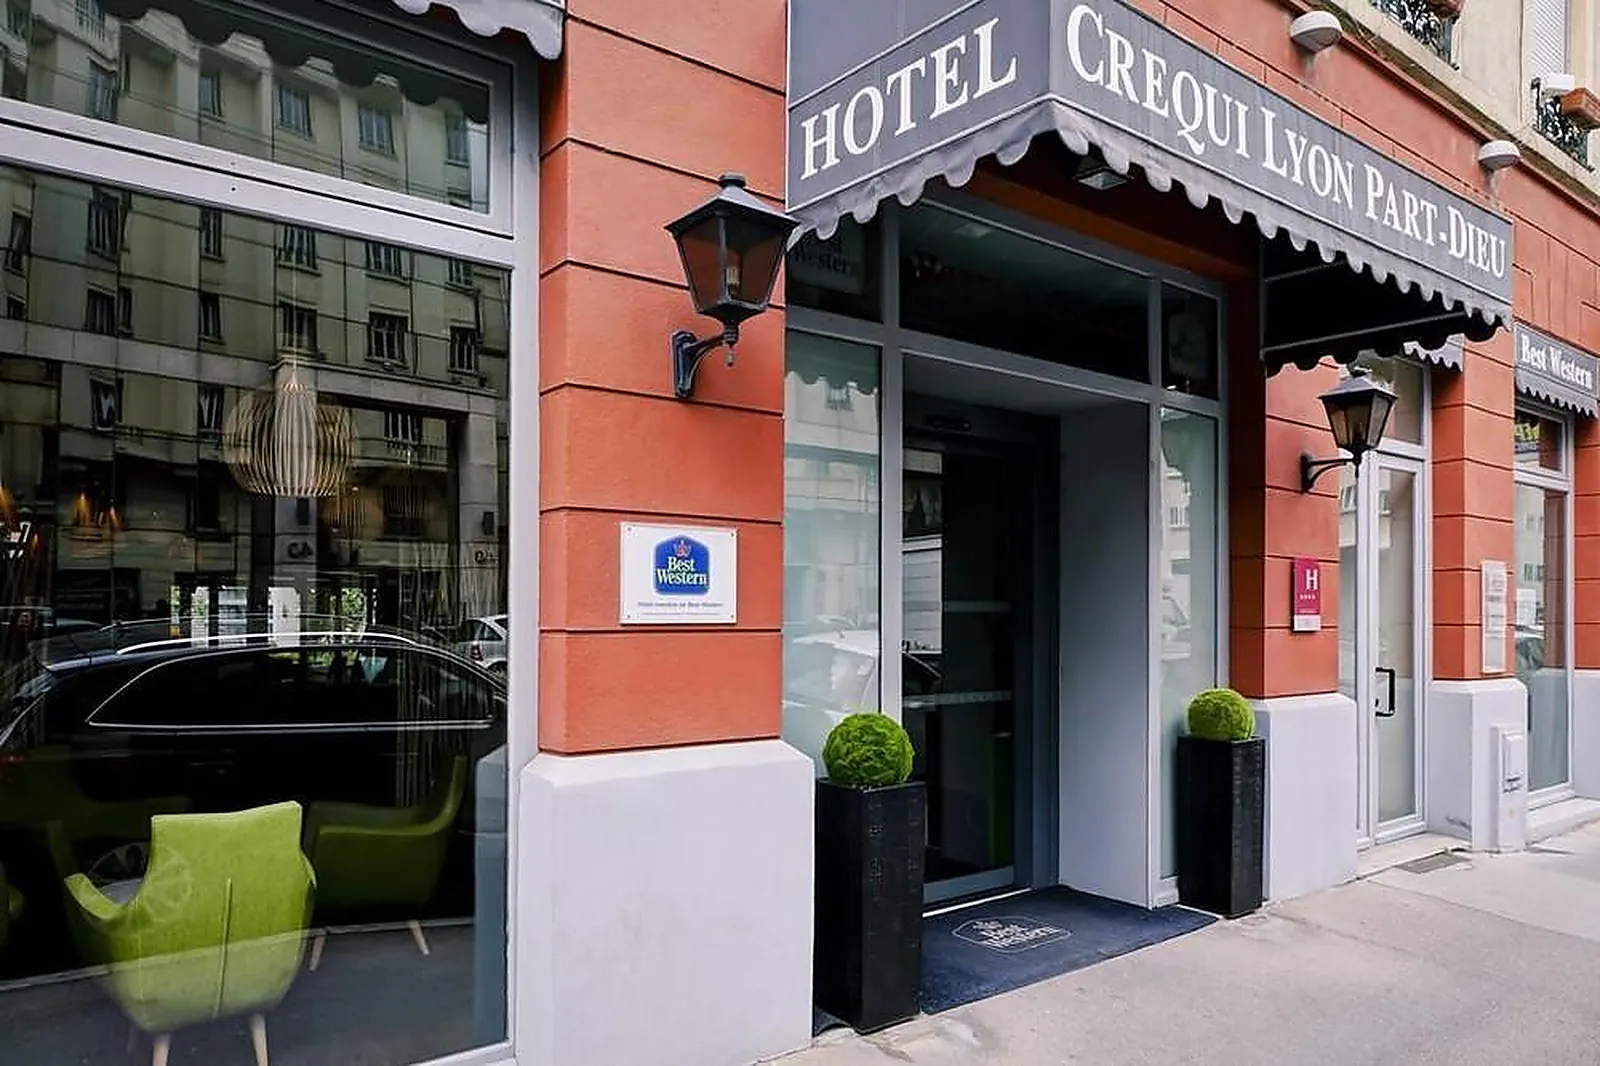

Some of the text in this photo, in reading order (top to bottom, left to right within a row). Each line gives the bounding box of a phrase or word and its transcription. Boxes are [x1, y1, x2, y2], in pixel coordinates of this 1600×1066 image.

[800, 17, 1018, 181] HOTEL
[1066, 4, 1507, 279] CREQUI LYON PART-DIEU
[1520, 333, 1593, 390] Best Western
[656, 568, 708, 585] Western
[667, 556, 696, 572] Best
[1305, 568, 1319, 590] H
